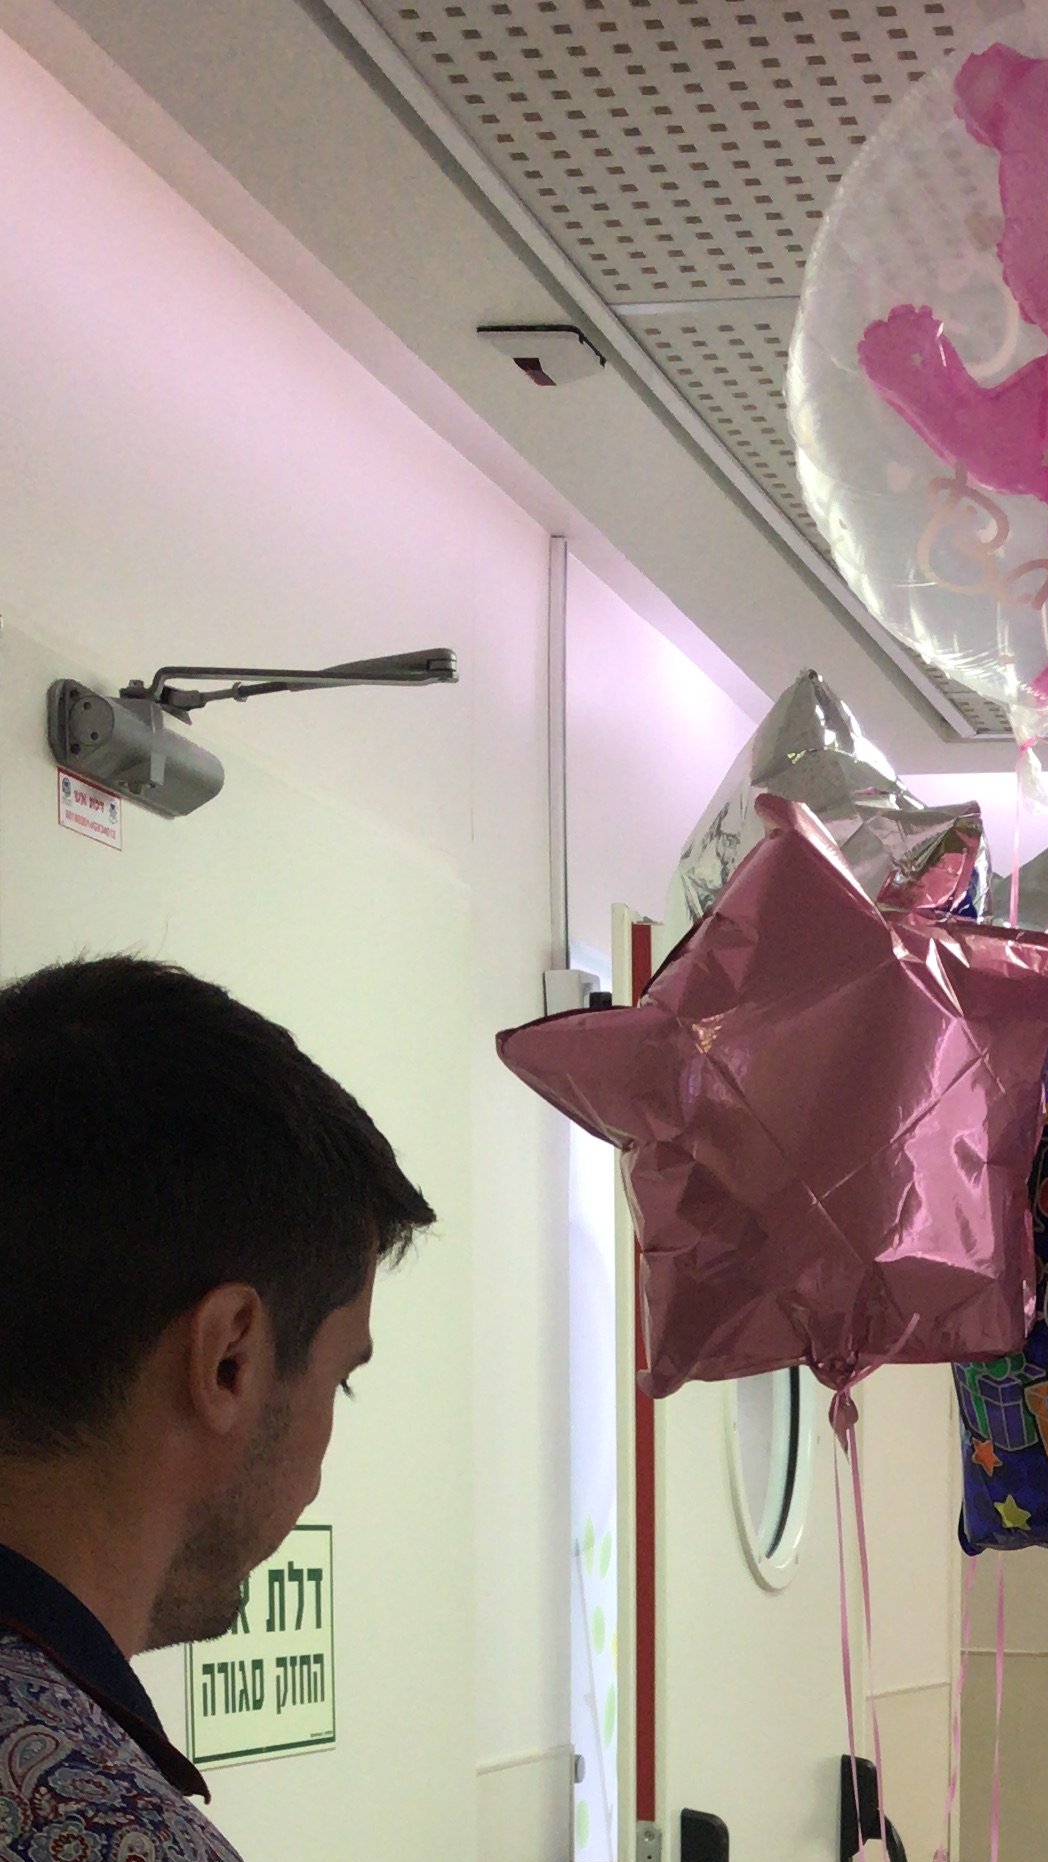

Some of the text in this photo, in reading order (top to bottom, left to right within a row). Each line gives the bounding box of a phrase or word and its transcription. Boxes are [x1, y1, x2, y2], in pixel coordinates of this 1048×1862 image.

[266, 1560, 323, 1633] דלת
[201, 1652, 325, 1717] החזק סגורה
